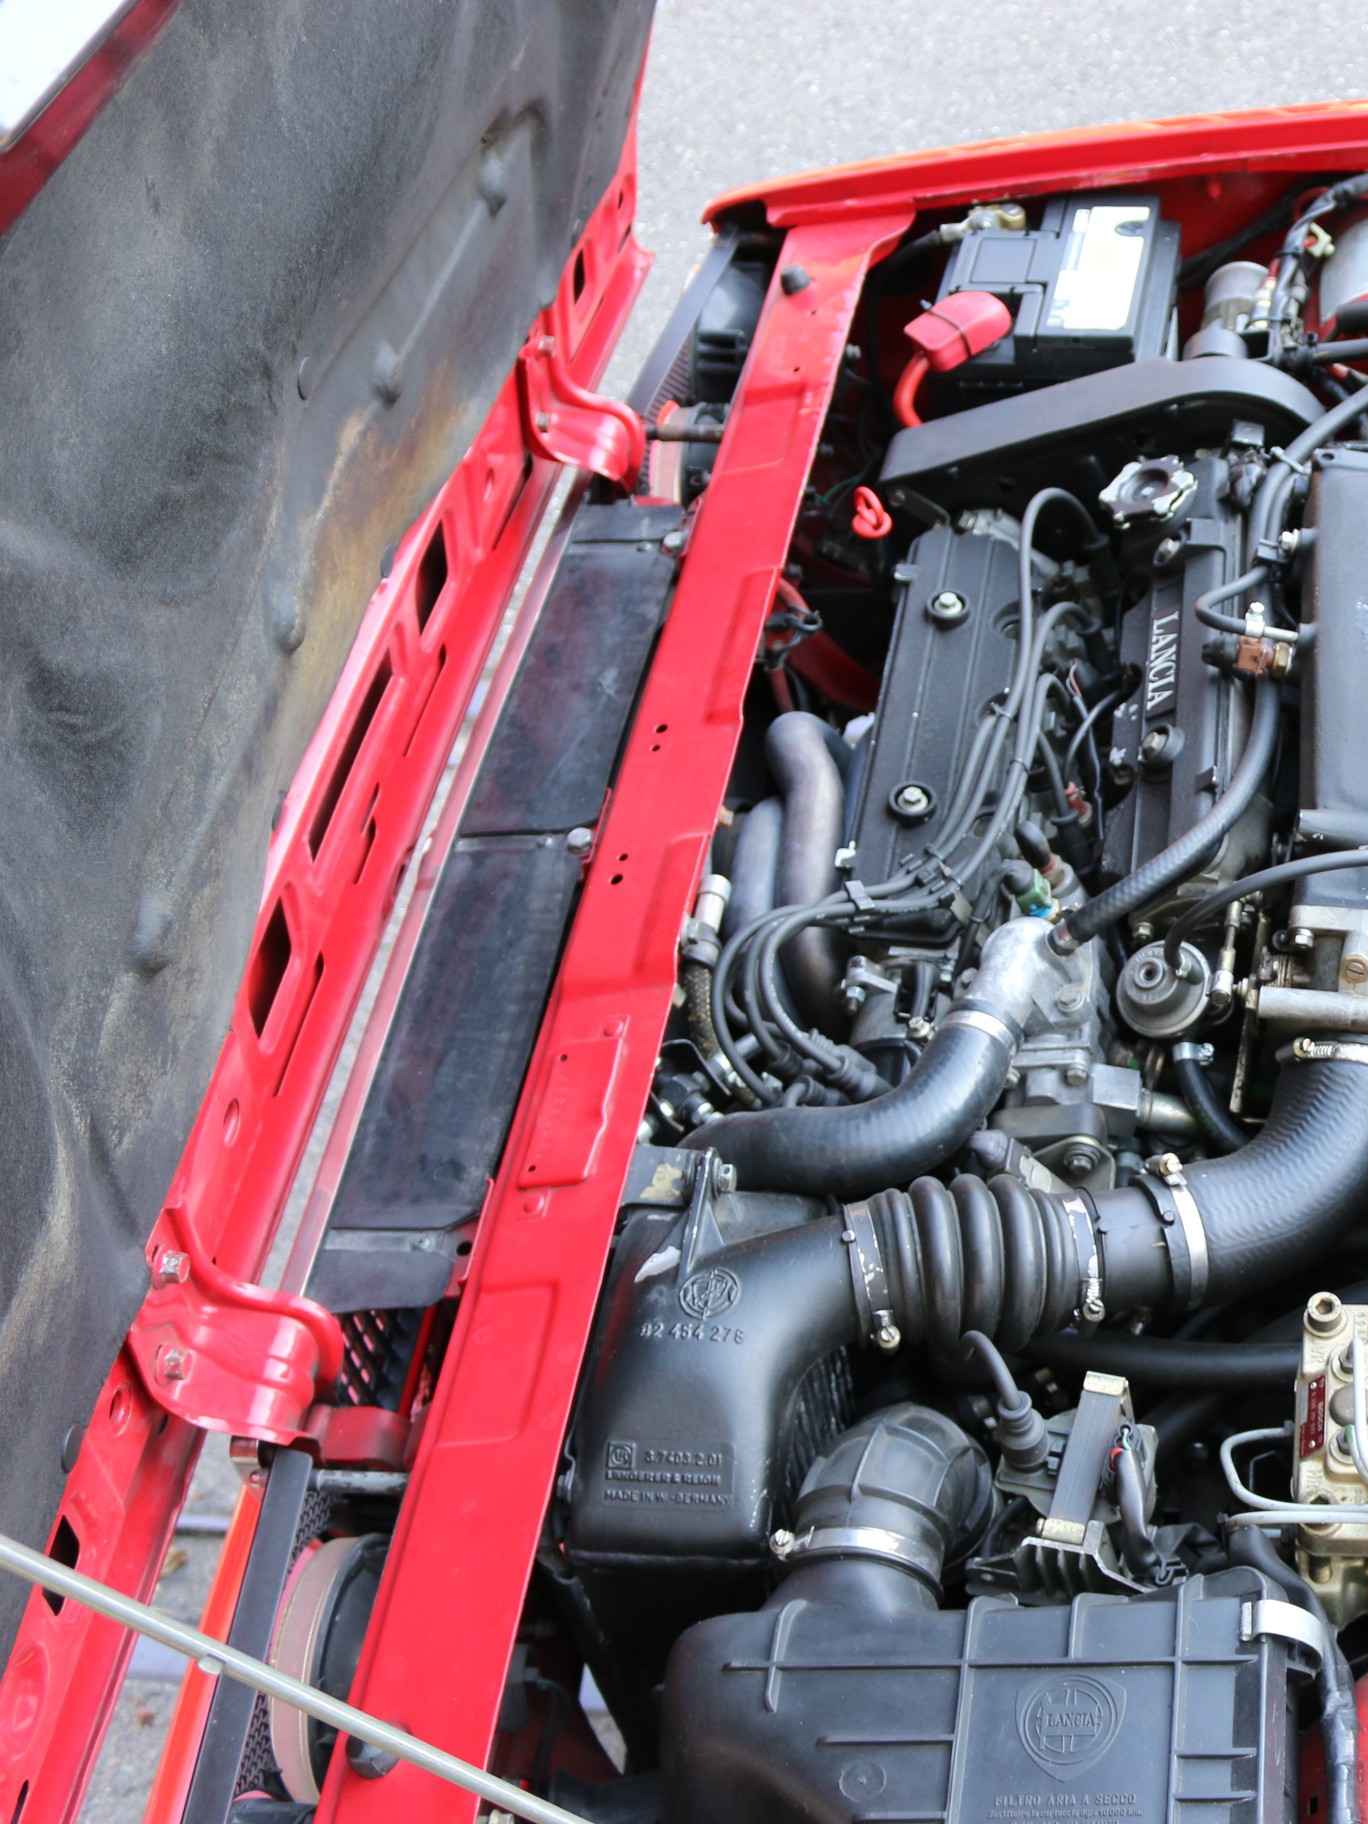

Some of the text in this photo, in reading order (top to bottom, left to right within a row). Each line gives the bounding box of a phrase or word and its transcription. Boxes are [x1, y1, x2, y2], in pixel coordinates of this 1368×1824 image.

[1146, 611, 1179, 711] LANCIA
[604, 1489, 640, 1503] MADE
[640, 1490, 653, 1503] IN
[1045, 1712, 1096, 1728] LANCIA
[995, 1793, 1137, 1807] FILTRO ARIA A SECCO
